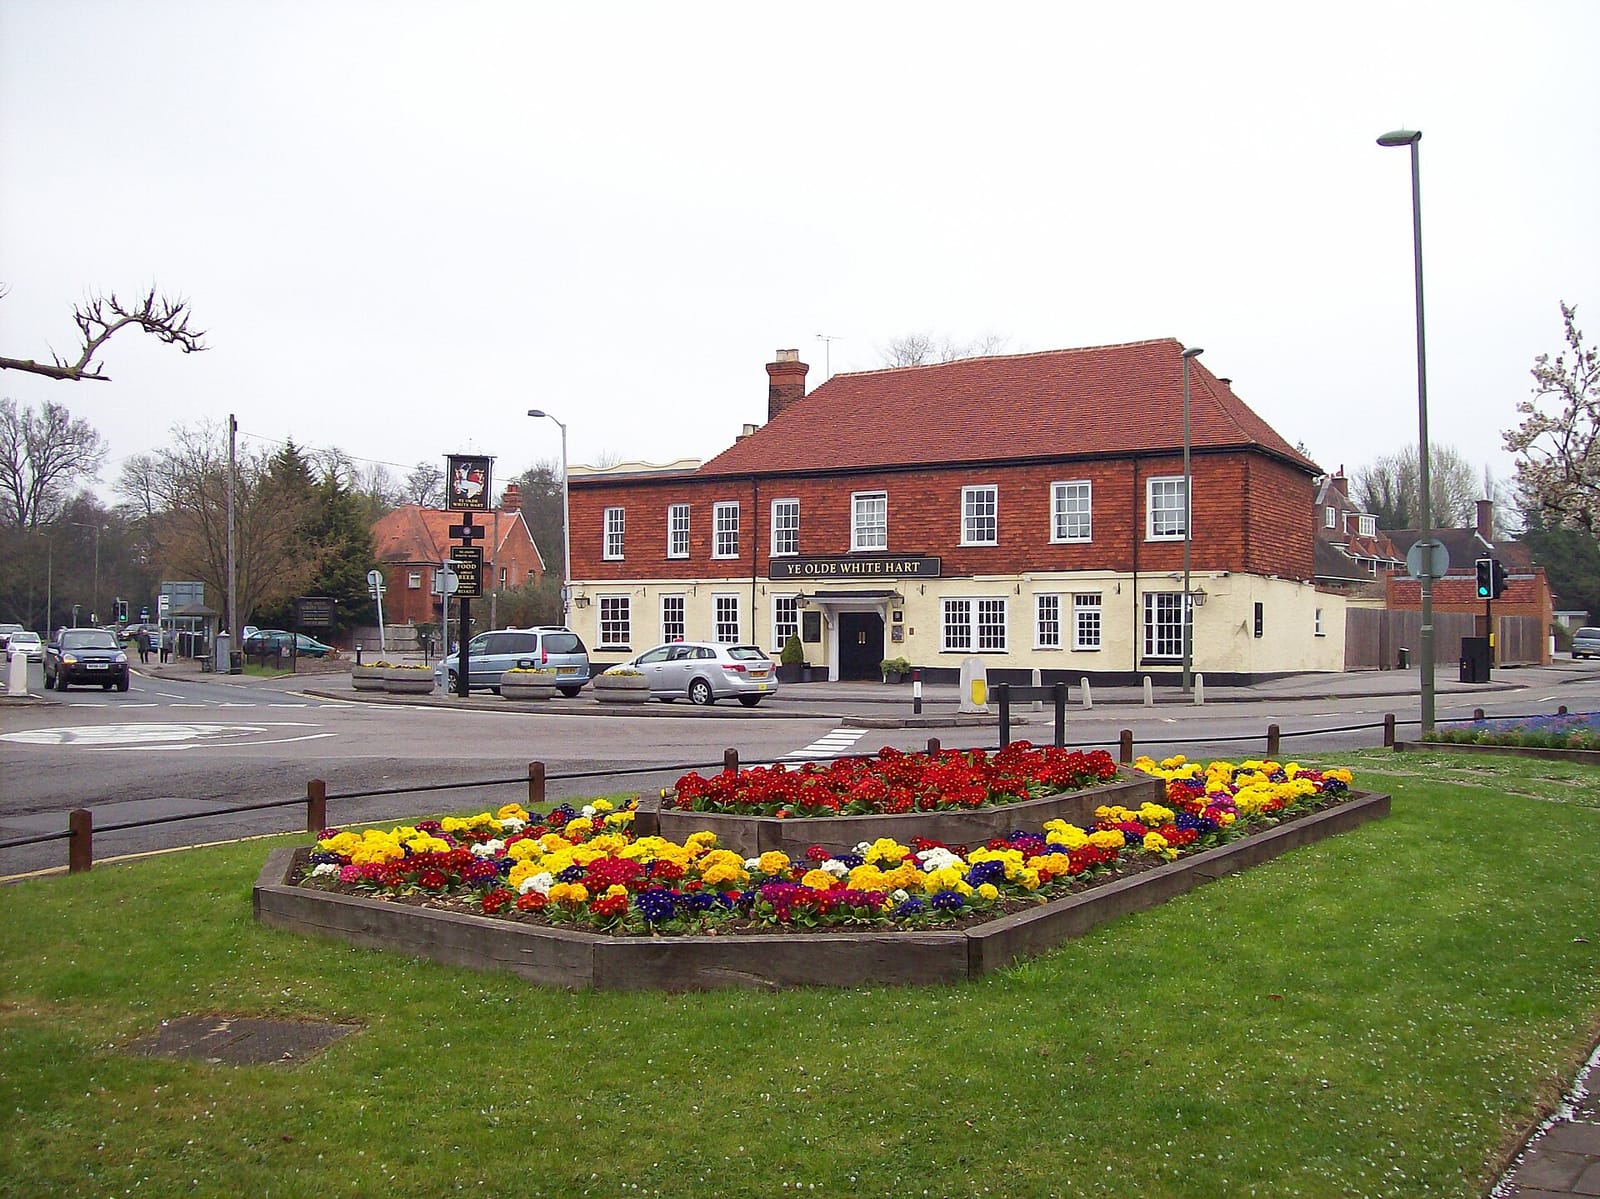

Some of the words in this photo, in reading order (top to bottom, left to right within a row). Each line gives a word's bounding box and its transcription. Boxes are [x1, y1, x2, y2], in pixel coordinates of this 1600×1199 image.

[787, 564, 802, 574] YE
[804, 563, 836, 574] OLDE
[840, 562, 881, 573] WHITE
[885, 562, 921, 573] HART
